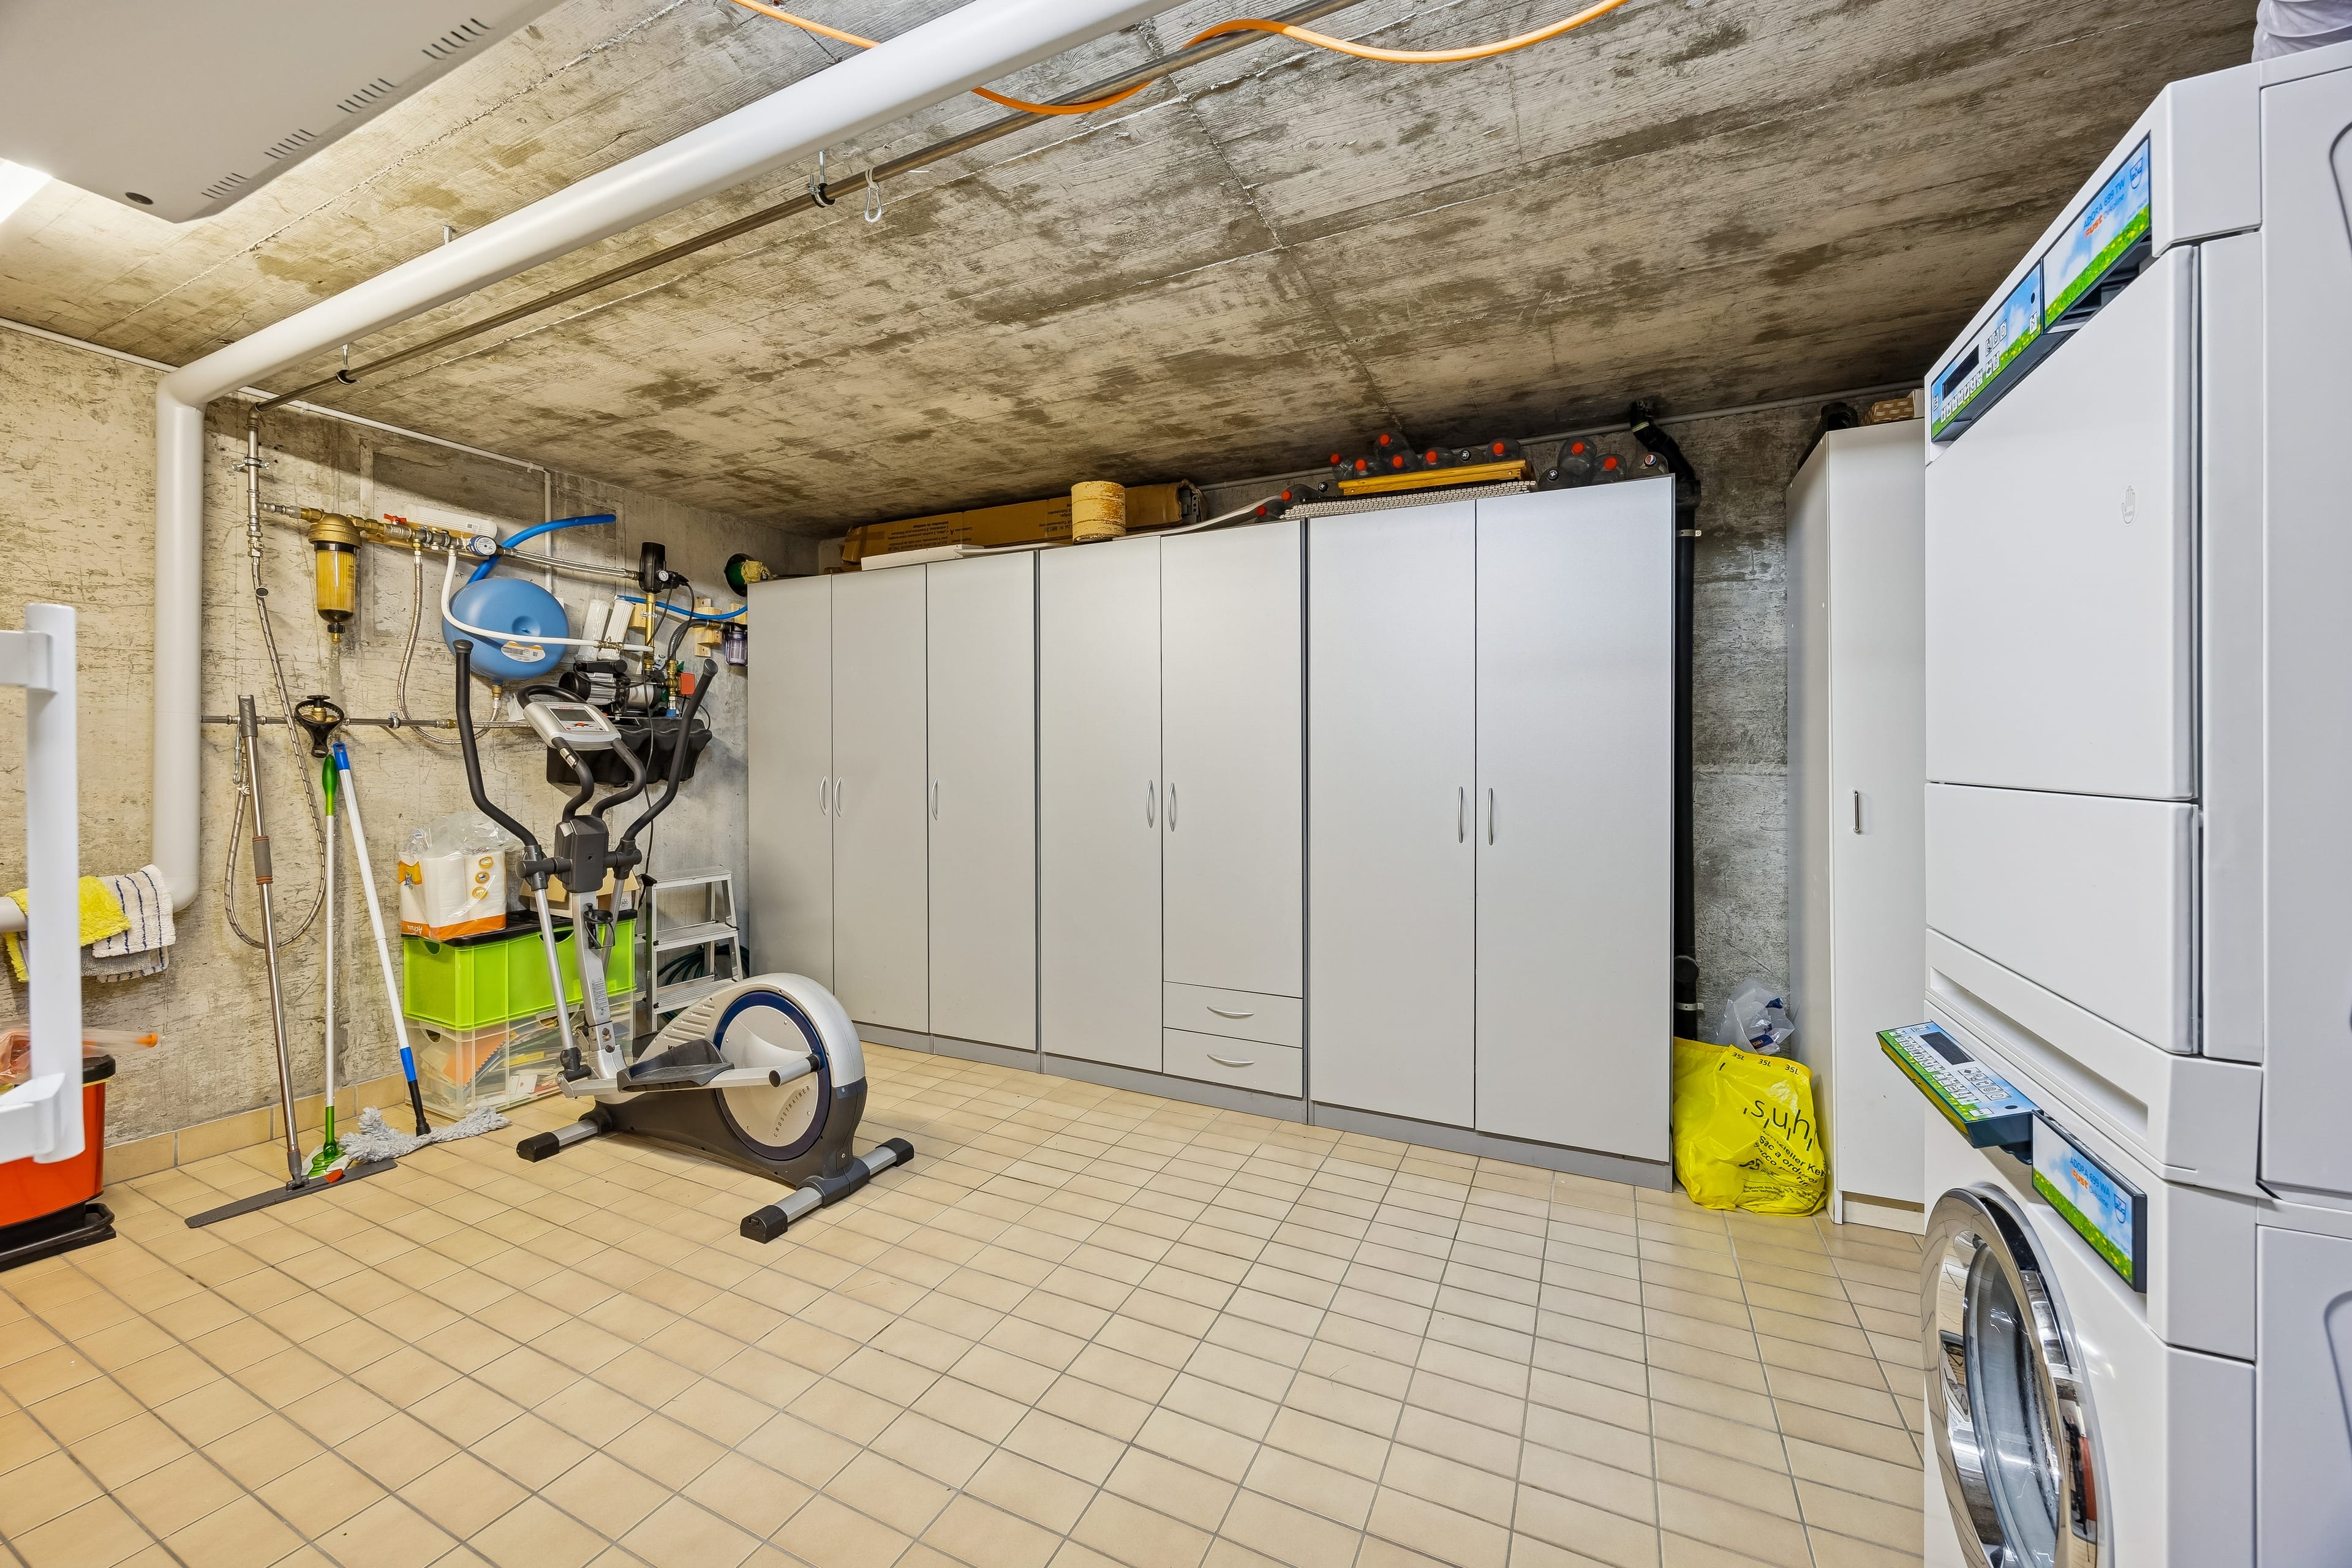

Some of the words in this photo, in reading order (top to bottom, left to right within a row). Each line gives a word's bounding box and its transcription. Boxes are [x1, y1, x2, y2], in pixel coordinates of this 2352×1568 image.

[2083, 203, 2103, 230] ADORA
[2103, 189, 2114, 206] 699
[2115, 178, 2125, 194] TW
[1732, 1052, 1745, 1061] 35L
[1758, 1058, 1771, 1067] 35L
[1785, 1064, 1799, 1076] 35L
[774, 1085, 810, 1137] CROSSTRAINER
[1759, 1136, 1774, 1151] Sac
[2070, 1156, 2088, 1179] ADORA
[2089, 1173, 2100, 1187] 699
[2100, 1181, 2111, 1197] WA
